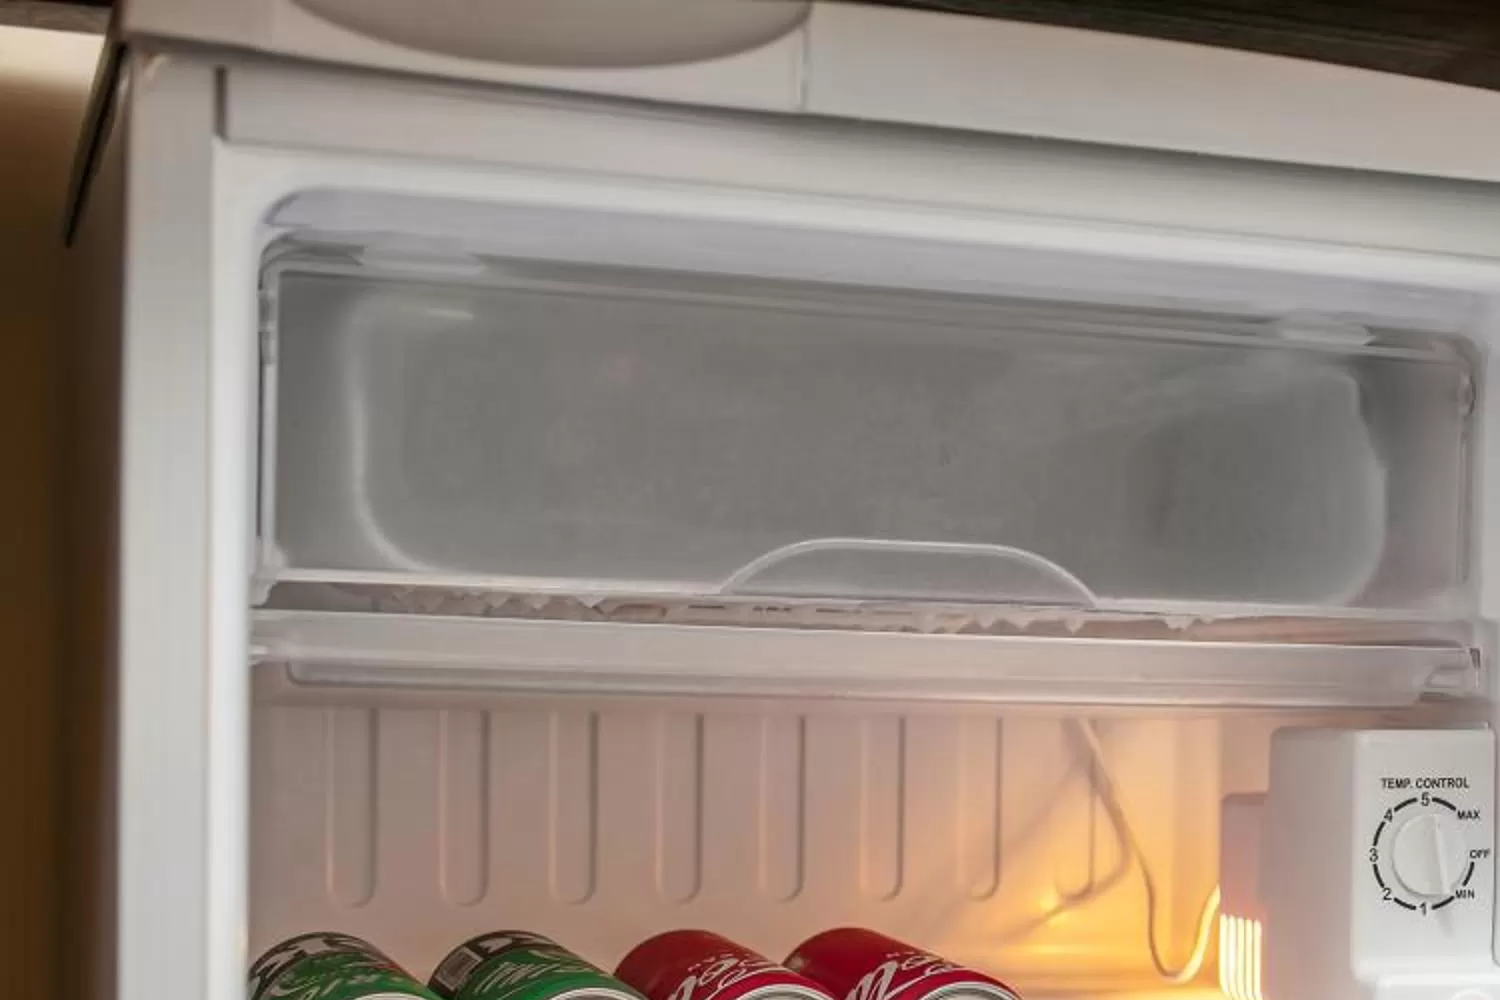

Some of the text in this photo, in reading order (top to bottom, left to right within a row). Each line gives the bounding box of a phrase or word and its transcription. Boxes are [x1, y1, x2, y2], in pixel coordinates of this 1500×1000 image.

[1381, 777, 1470, 789] TEMP. CONTROL
[1420, 792, 1430, 807] 5
[1383, 808, 1393, 822] 4
[1457, 810, 1480, 820] MAX
[1369, 847, 1379, 862] 3
[1469, 849, 1490, 859] OFF
[1382, 887, 1392, 901] 2
[1455, 889, 1475, 899] MIN
[1419, 902, 1427, 916] 1
